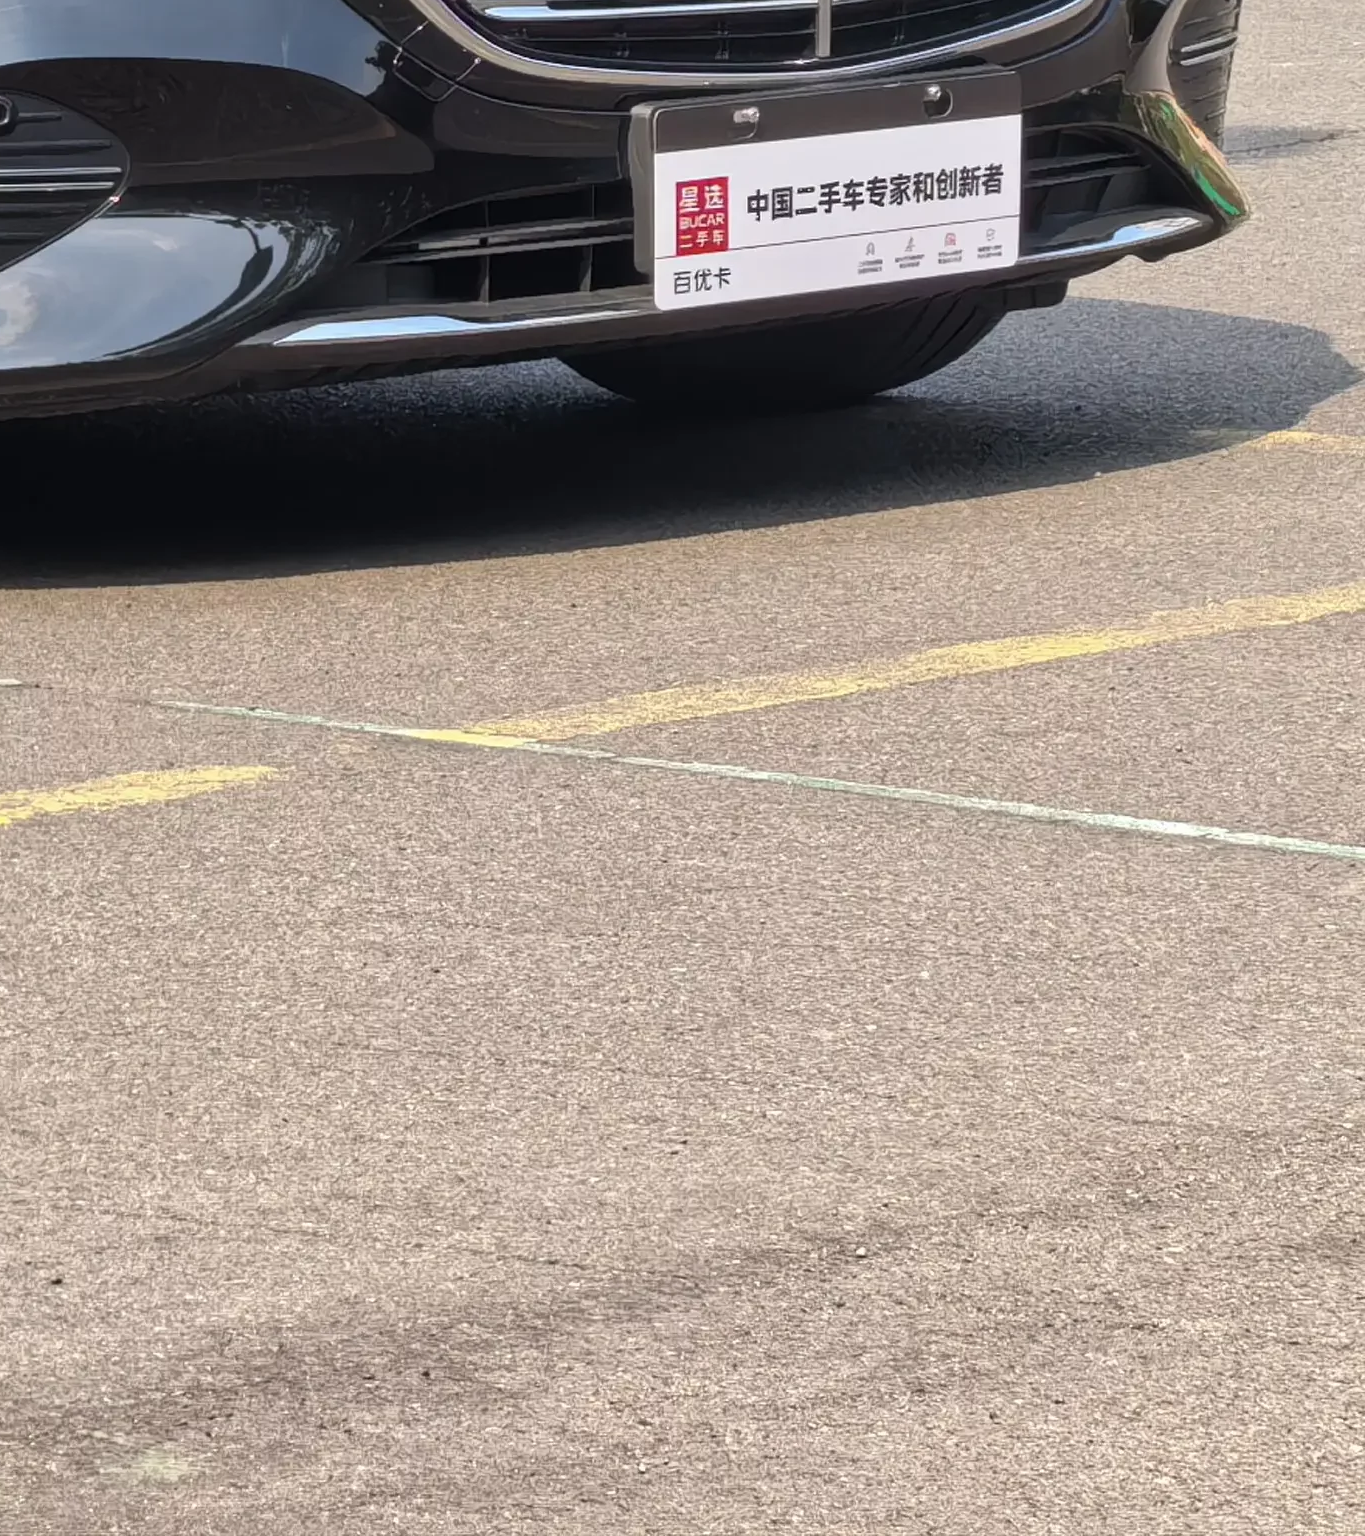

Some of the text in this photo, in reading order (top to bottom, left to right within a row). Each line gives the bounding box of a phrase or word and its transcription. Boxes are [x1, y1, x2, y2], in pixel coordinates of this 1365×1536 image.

[746, 163, 1004, 222] 中国二手车专家和创新者
[679, 213, 725, 230] BUCAR
[679, 230, 725, 248] 二手车
[673, 267, 732, 295] 百优卡
